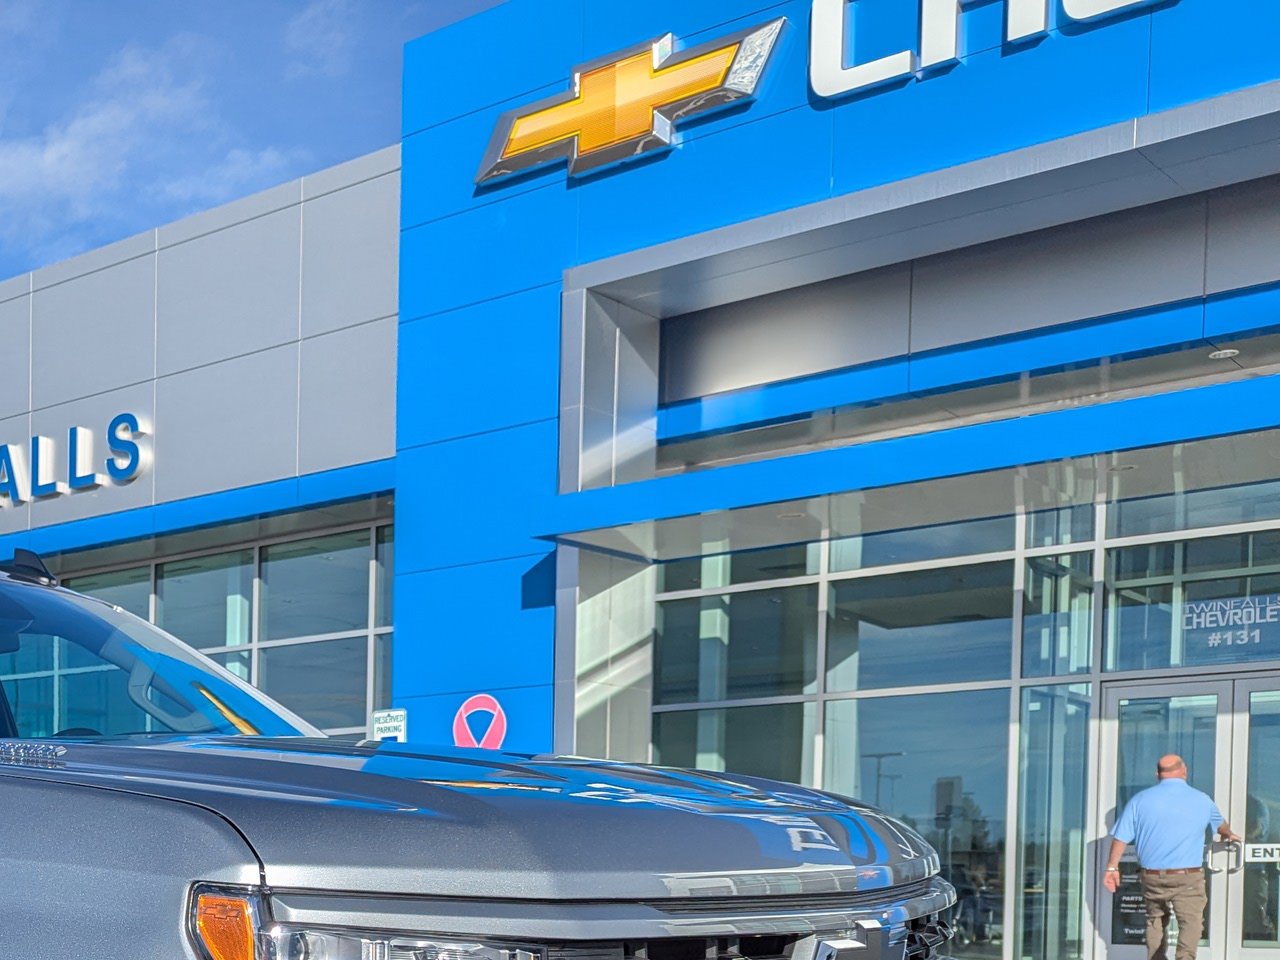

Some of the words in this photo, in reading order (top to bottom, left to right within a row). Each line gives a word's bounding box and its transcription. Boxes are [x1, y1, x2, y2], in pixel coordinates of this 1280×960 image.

[1207, 629, 1261, 648] #131
[374, 714, 405, 725] RESERVED
[376, 724, 403, 735] PARKING
